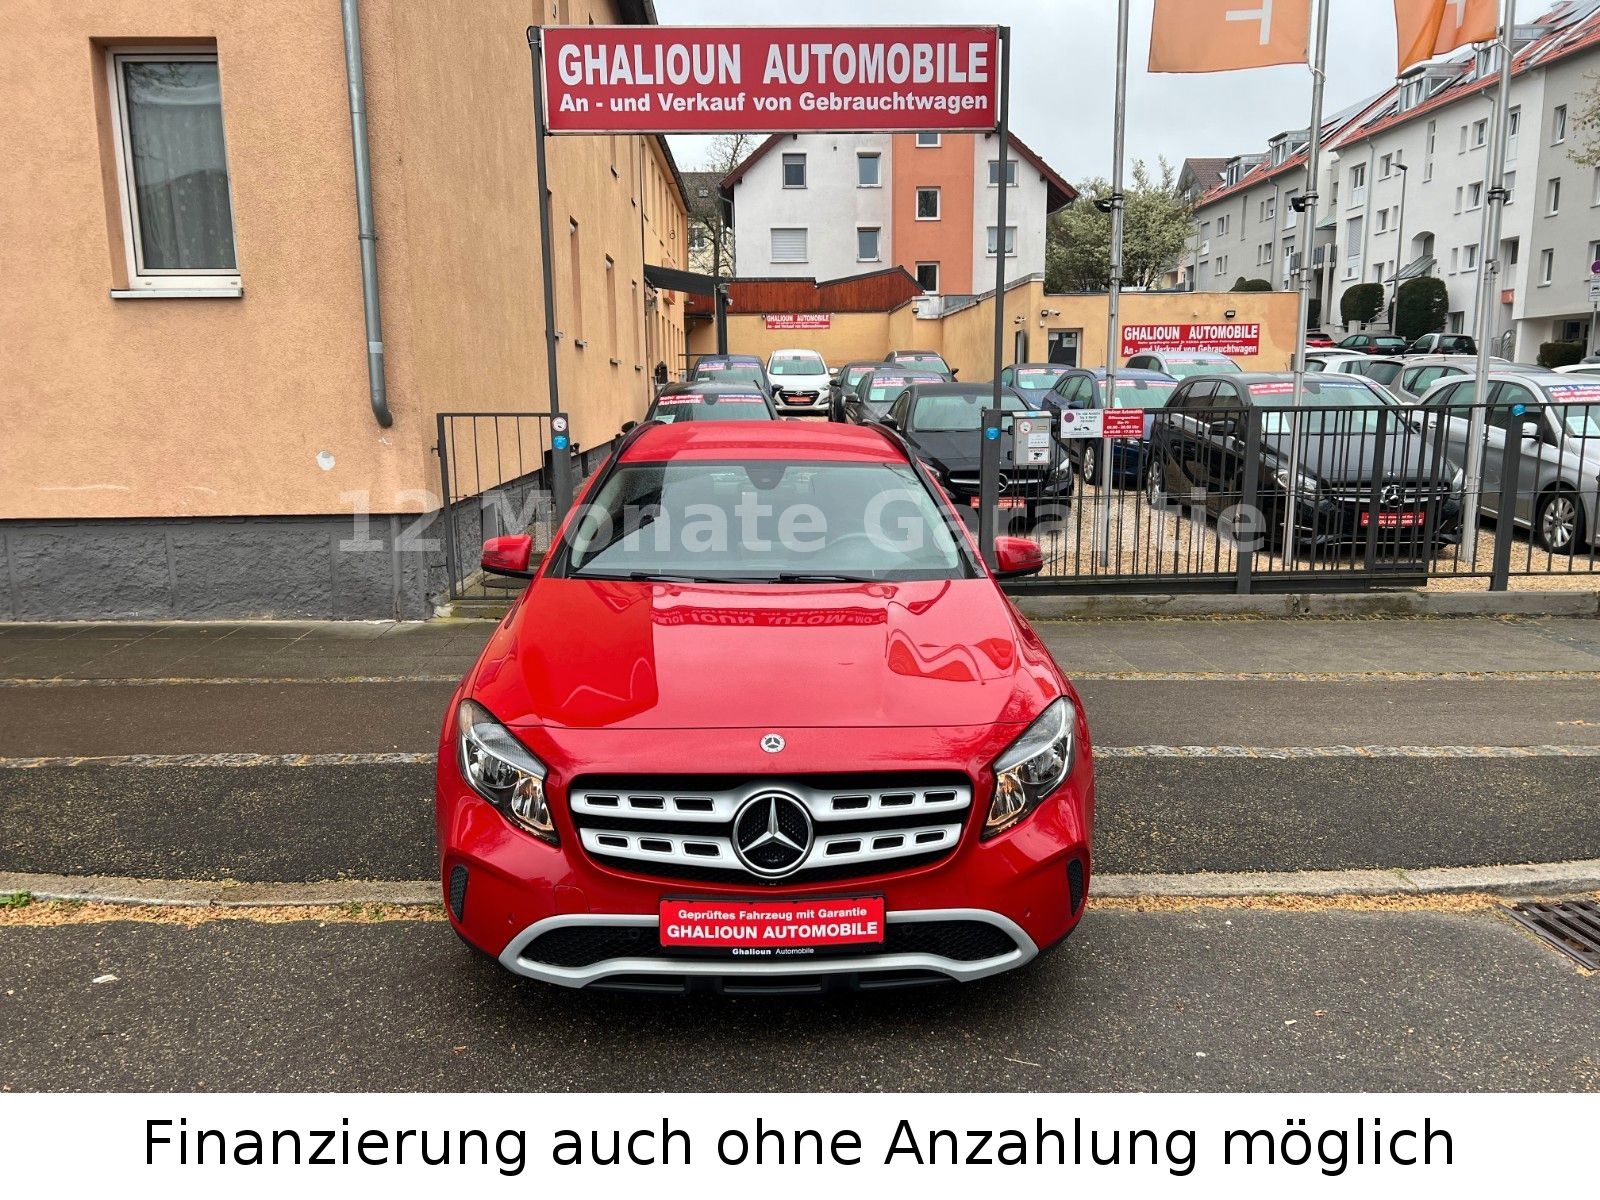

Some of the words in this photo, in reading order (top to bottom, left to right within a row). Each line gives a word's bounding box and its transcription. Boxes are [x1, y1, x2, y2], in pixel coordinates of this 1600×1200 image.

[558, 43, 742, 86] GHALIOUN
[762, 42, 988, 85] AUTOMOBILE
[559, 93, 589, 112] An
[609, 92, 650, 112] und
[657, 91, 746, 112] Verkauf
[752, 95, 792, 111] von
[798, 91, 988, 116] Gebrauchtwagen
[1124, 326, 1181, 340] GHALIOUN
[1188, 325, 1258, 339] AUTOMOBILE
[1123, 345, 1134, 355] An
[1198, 344, 1257, 355] Gebrauchtwagen
[678, 908, 736, 921] Geprüftes
[739, 909, 793, 921] Fahrzeug
[796, 908, 815, 919] mit
[818, 907, 867, 919] Garantie
[667, 924, 758, 939] GHALIOUN
[762, 921, 878, 938] AUTOMOBILE
[732, 947, 772, 955] Ghalioun
[775, 947, 815, 955] Automobile
